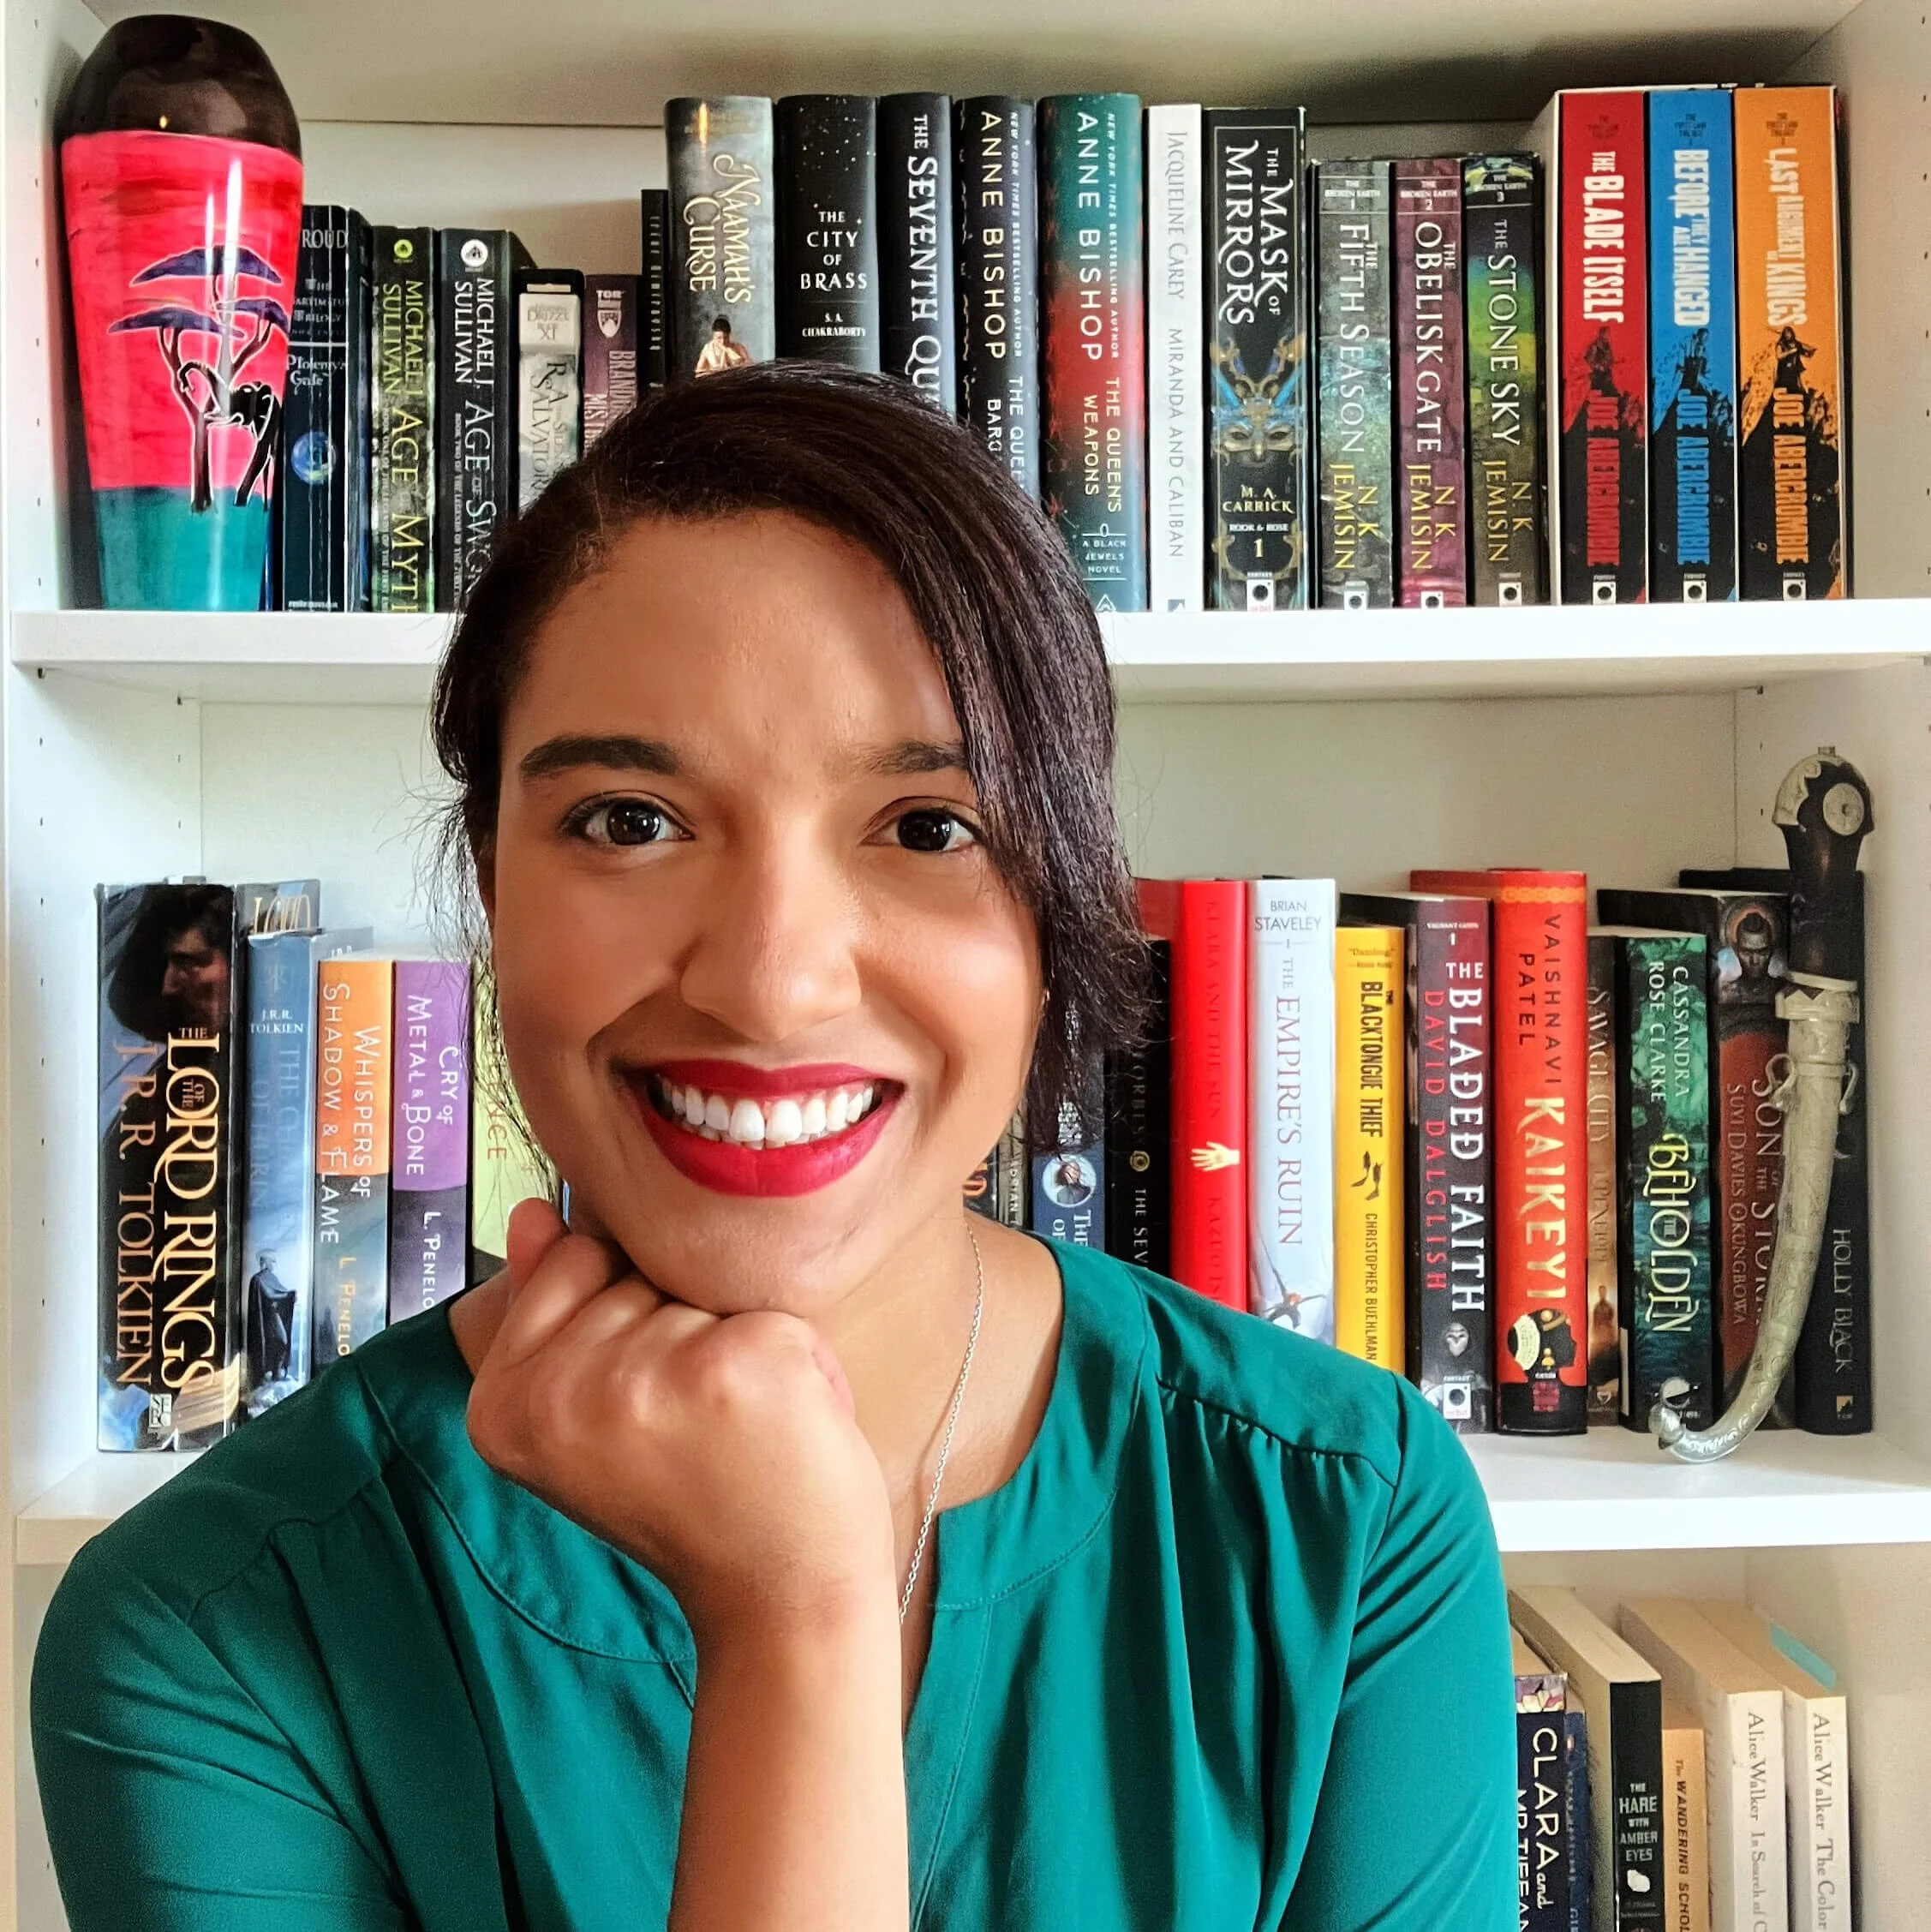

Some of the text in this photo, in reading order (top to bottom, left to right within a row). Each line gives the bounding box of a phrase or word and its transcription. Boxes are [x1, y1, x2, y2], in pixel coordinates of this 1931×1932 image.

[1425, 200, 1433, 211] 2
[1591, 150, 1617, 173] THE
[1667, 149, 1710, 219] BEFORE
[1763, 147, 1799, 194] LAST
[683, 195, 720, 292] CURSE
[713, 153, 762, 303] NAAMAH'S
[807, 231, 858, 248] CITY
[818, 211, 846, 223] THE
[823, 254, 842, 266] OF
[907, 114, 939, 322] THE SEVENTH
[981, 111, 1006, 360] ANNE BISHOP
[1076, 111, 1103, 361] ANNE BISHOP
[1218, 140, 1259, 325] MIRRORS
[1253, 147, 1294, 315] THE MASK OF
[1582, 175, 1624, 250] BLADE
[800, 272, 868, 292] BRASS
[825, 312, 844, 323] S. A.
[1582, 256, 1627, 324] ITSELF
[1673, 246, 1710, 326] HANGED
[1766, 262, 1808, 326] KINGS
[383, 284, 402, 394] SULLIVAN
[405, 280, 424, 381] MICHAEL
[455, 281, 472, 384] SULLIVAN
[474, 278, 494, 389] MICHAEL J.
[802, 326, 867, 338] CHAKRABORTY
[1164, 131, 1188, 558] JACQUELINE CAREY MIRANDA AND CALIBAN
[1340, 224, 1378, 452] THE FIFTH SEASON
[1415, 221, 1456, 453] THE OBELISK GATE
[1488, 218, 1521, 446] THE STONE SKY
[392, 407, 424, 485] AGE
[464, 399, 494, 471] AGE
[1083, 394, 1099, 496] WEAPONS
[1105, 377, 1121, 513] THE QUEEN'S
[1587, 388, 1619, 431] JOE
[1677, 388, 1708, 431] JOE
[1773, 387, 1804, 429] JOE
[1222, 500, 1296, 514] CARRICK
[1241, 484, 1276, 499] M. A.
[1330, 464, 1355, 569] JEMISIN
[1406, 464, 1432, 569] JEMISIN
[1482, 460, 1510, 562] JEMISIN
[1587, 437, 1620, 567] ABERCROMBIE
[1677, 435, 1711, 565] ABERCROMBIE
[1773, 434, 1809, 565] ABERCROMBIE
[1085, 553, 1125, 561] JEWELS
[1087, 565, 1121, 574] NOVEL
[1253, 538, 1264, 558] 1
[1254, 917, 1322, 930] STAVELEY
[1270, 900, 1306, 912] BRIAN
[179, 1027, 207, 1038] THE
[250, 1022, 304, 1034] TOLKIEN
[261, 1008, 293, 1020] J.R.R.
[1518, 953, 1536, 1046] PATEL
[1544, 913, 1562, 1084] VAISHNAVI
[1648, 960, 1667, 1103] ROSE CLARKE
[1672, 966, 1690, 1098] CASSANDRA
[182, 1078, 194, 1109] THE
[194, 1082, 206, 1104] OF
[322, 983, 350, 1111] SHADOW
[402, 994, 433, 1175] METAL & BONE
[436, 1045, 461, 1126] CRY OF
[1360, 981, 1384, 1138] BLACKTONGUE THIEF
[154, 1032, 220, 1199] LORD
[322, 1123, 338, 1136] &
[350, 1025, 382, 1198] WHISPERS OF
[1276, 957, 1302, 1246] THE EMPIRE'S RUIN
[1424, 990, 1447, 1289] DAVID DALGLISH
[1445, 962, 1485, 1312] THE BLADED FAITH
[113, 1040, 158, 1387] J. R. R. TOLKIEN
[320, 1145, 348, 1245] FLAME
[1516, 1097, 1566, 1300] KAIKEYI
[1728, 1133, 1749, 1198] DAVIES
[422, 1211, 441, 1230] L.
[1642, 1132, 1701, 1332] BEHOLDEN
[1728, 1205, 1749, 1325] OKUNGBOWA
[152, 1210, 218, 1390] RINGS
[1364, 1212, 1378, 1361] CHRISTOPHER BUEHLMAN
[1830, 1229, 1854, 1375] HOLLY BLACK
[1748, 1711, 1765, 1759] Alice
[1532, 1726, 1560, 1911] CLARA and
[1618, 1796, 1658, 1815] HARE
[1628, 1817, 1650, 1827] WITH
[1629, 1783, 1647, 1792] THE
[1675, 1780, 1689, 1875] WANDERING
[1749, 1760, 1767, 1821] Walker
[1814, 1713, 1836, 1928] Alice Walker The Color
[1619, 1831, 1659, 1845] AMBER
[1625, 1848, 1653, 1862] EYES
